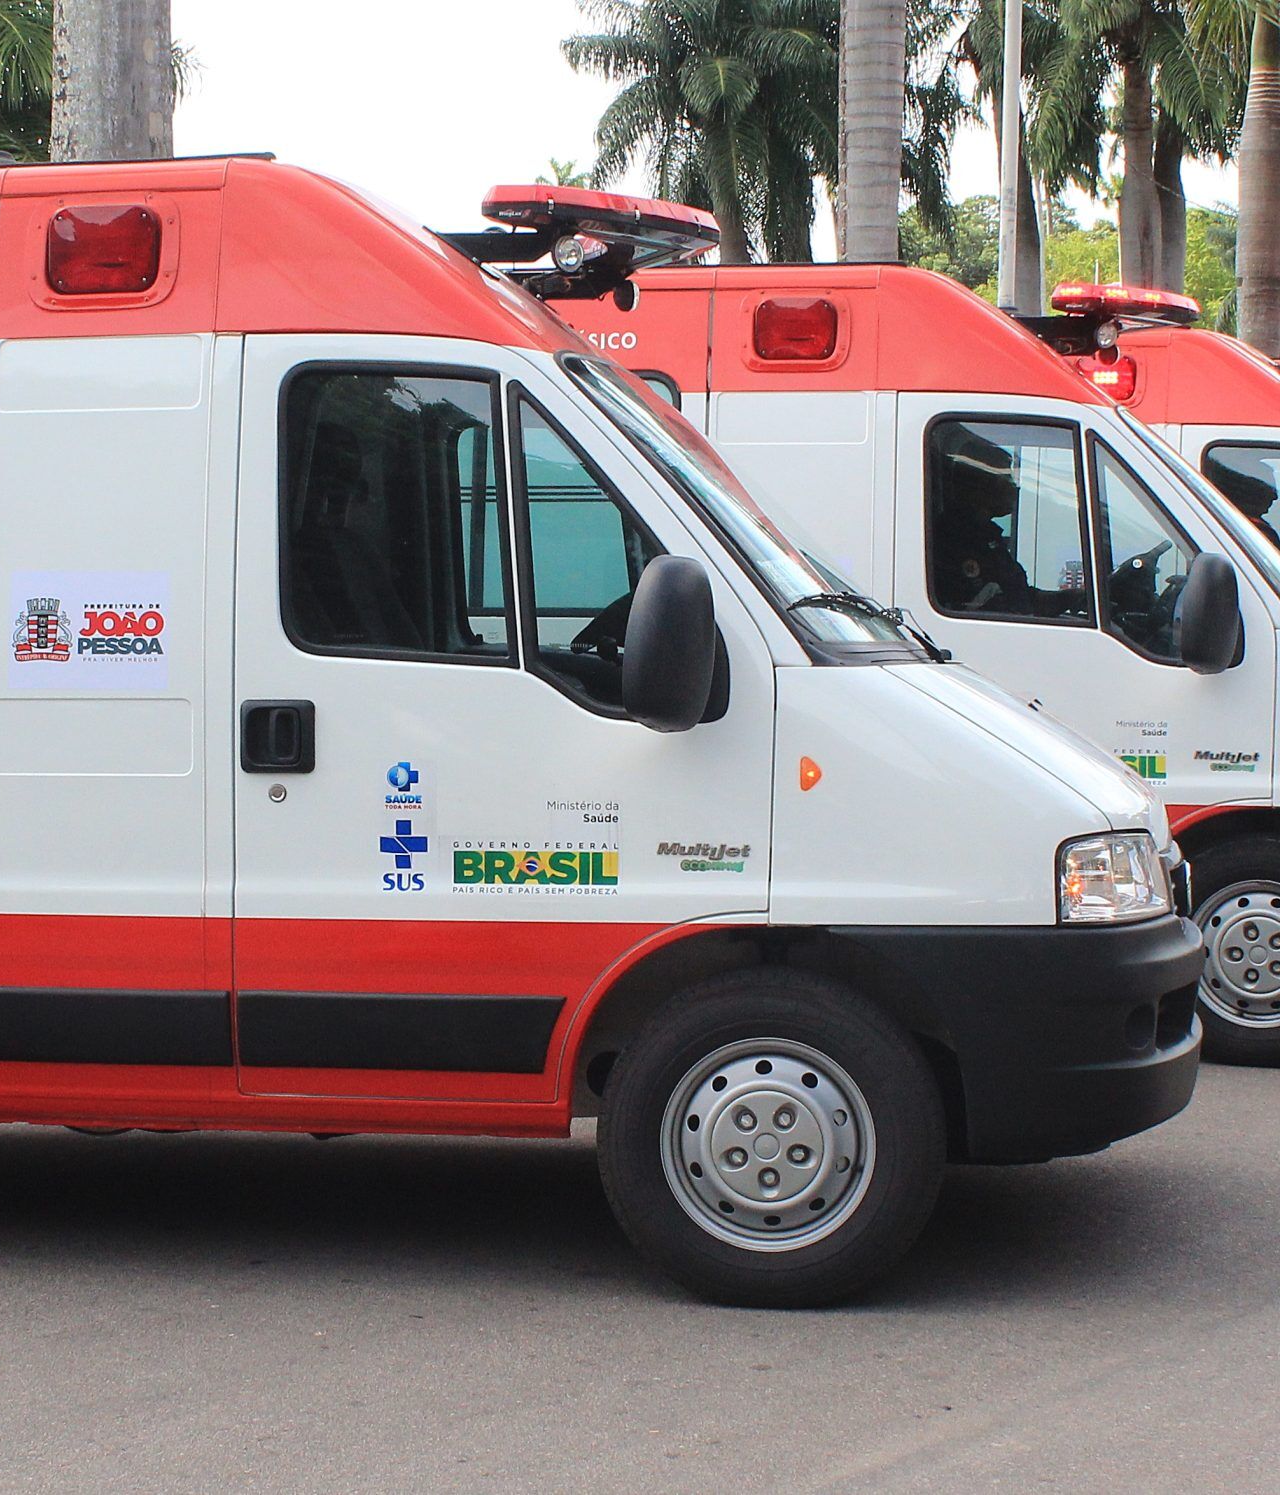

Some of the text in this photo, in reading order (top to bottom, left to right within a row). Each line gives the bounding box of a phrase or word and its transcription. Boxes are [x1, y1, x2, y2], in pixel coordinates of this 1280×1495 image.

[580, 330, 637, 350] SICO
[79, 610, 164, 637] JOÃO
[77, 637, 164, 655] PESSOA
[1116, 720, 1155, 728] Ministério
[1141, 728, 1167, 736] Saúde
[385, 793, 422, 804] SAÚDE
[546, 800, 619, 811] Ministério da
[583, 813, 619, 823] Saúde
[453, 841, 531, 849] GOVERNO
[453, 851, 618, 885] BRASIL
[383, 873, 425, 891] SUS
[508, 886, 513, 894] É
[518, 886, 540, 894] PAÍS
